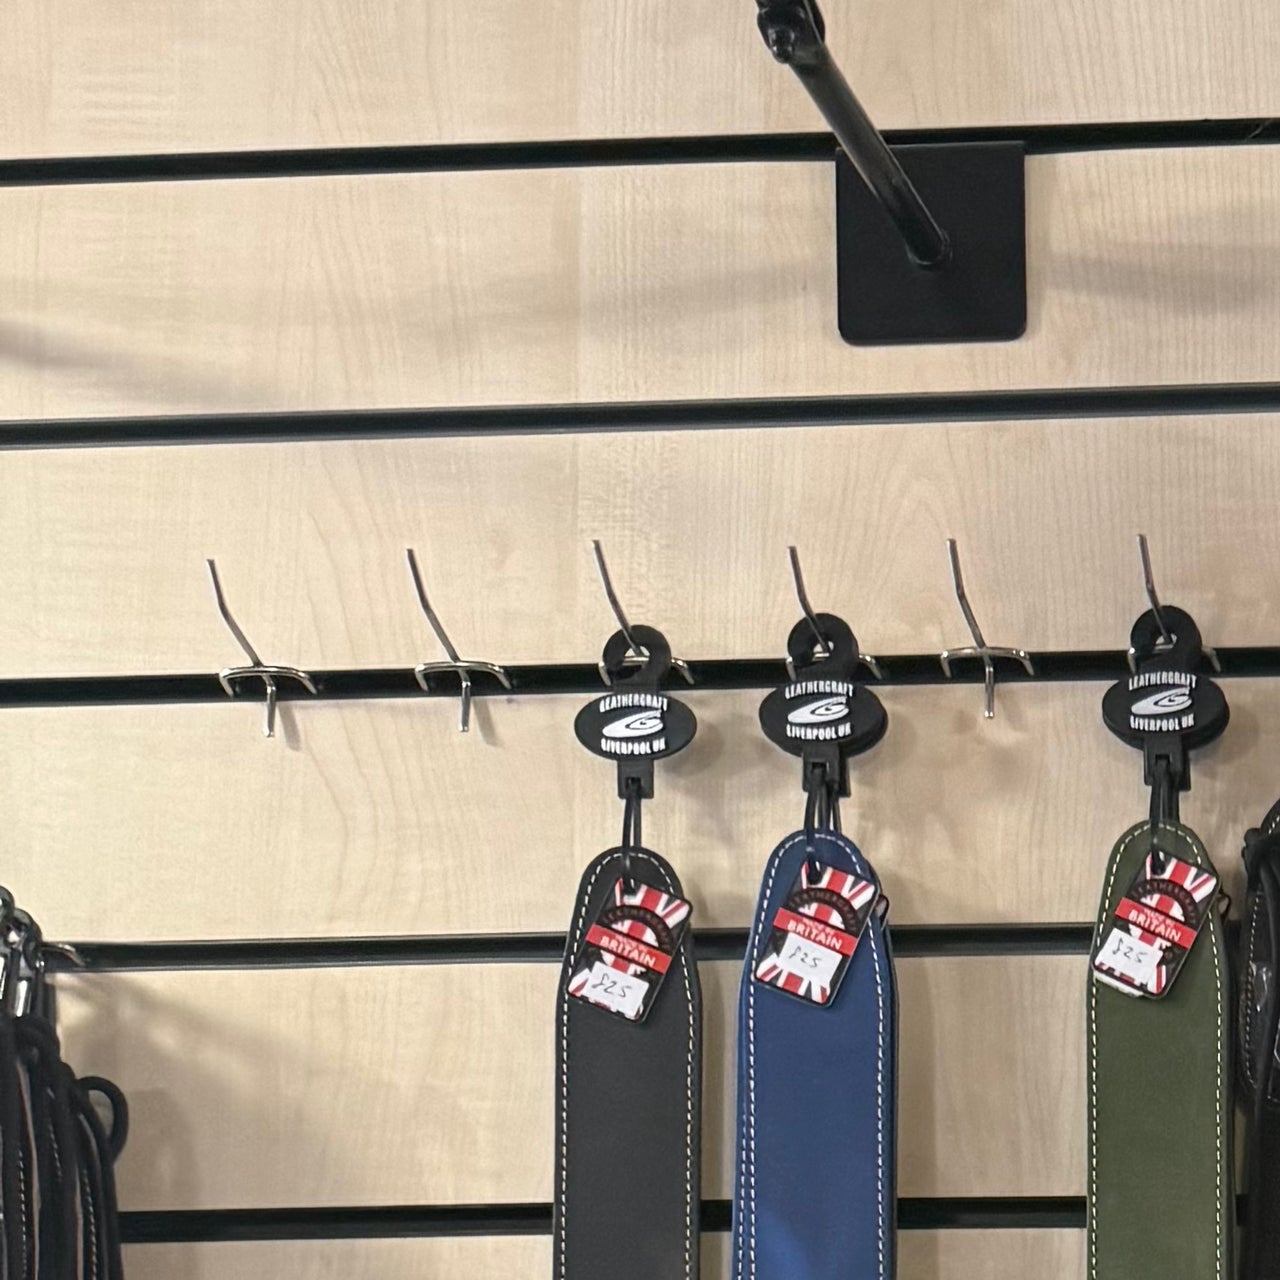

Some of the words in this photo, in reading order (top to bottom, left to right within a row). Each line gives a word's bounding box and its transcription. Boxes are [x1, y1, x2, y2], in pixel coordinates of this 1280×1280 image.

[786, 723, 837, 740] LIVERPOOL
[838, 722, 852, 737] UK
[1130, 714, 1180, 731] LIVERPOOL
[1181, 713, 1195, 728] UK
[601, 738, 652, 755] LIVERPOOL
[653, 737, 666, 752] UK
[787, 919, 843, 950] BRITAIN
[1128, 909, 1182, 942] BRITAIN
[600, 936, 656, 967] BRITAIN
